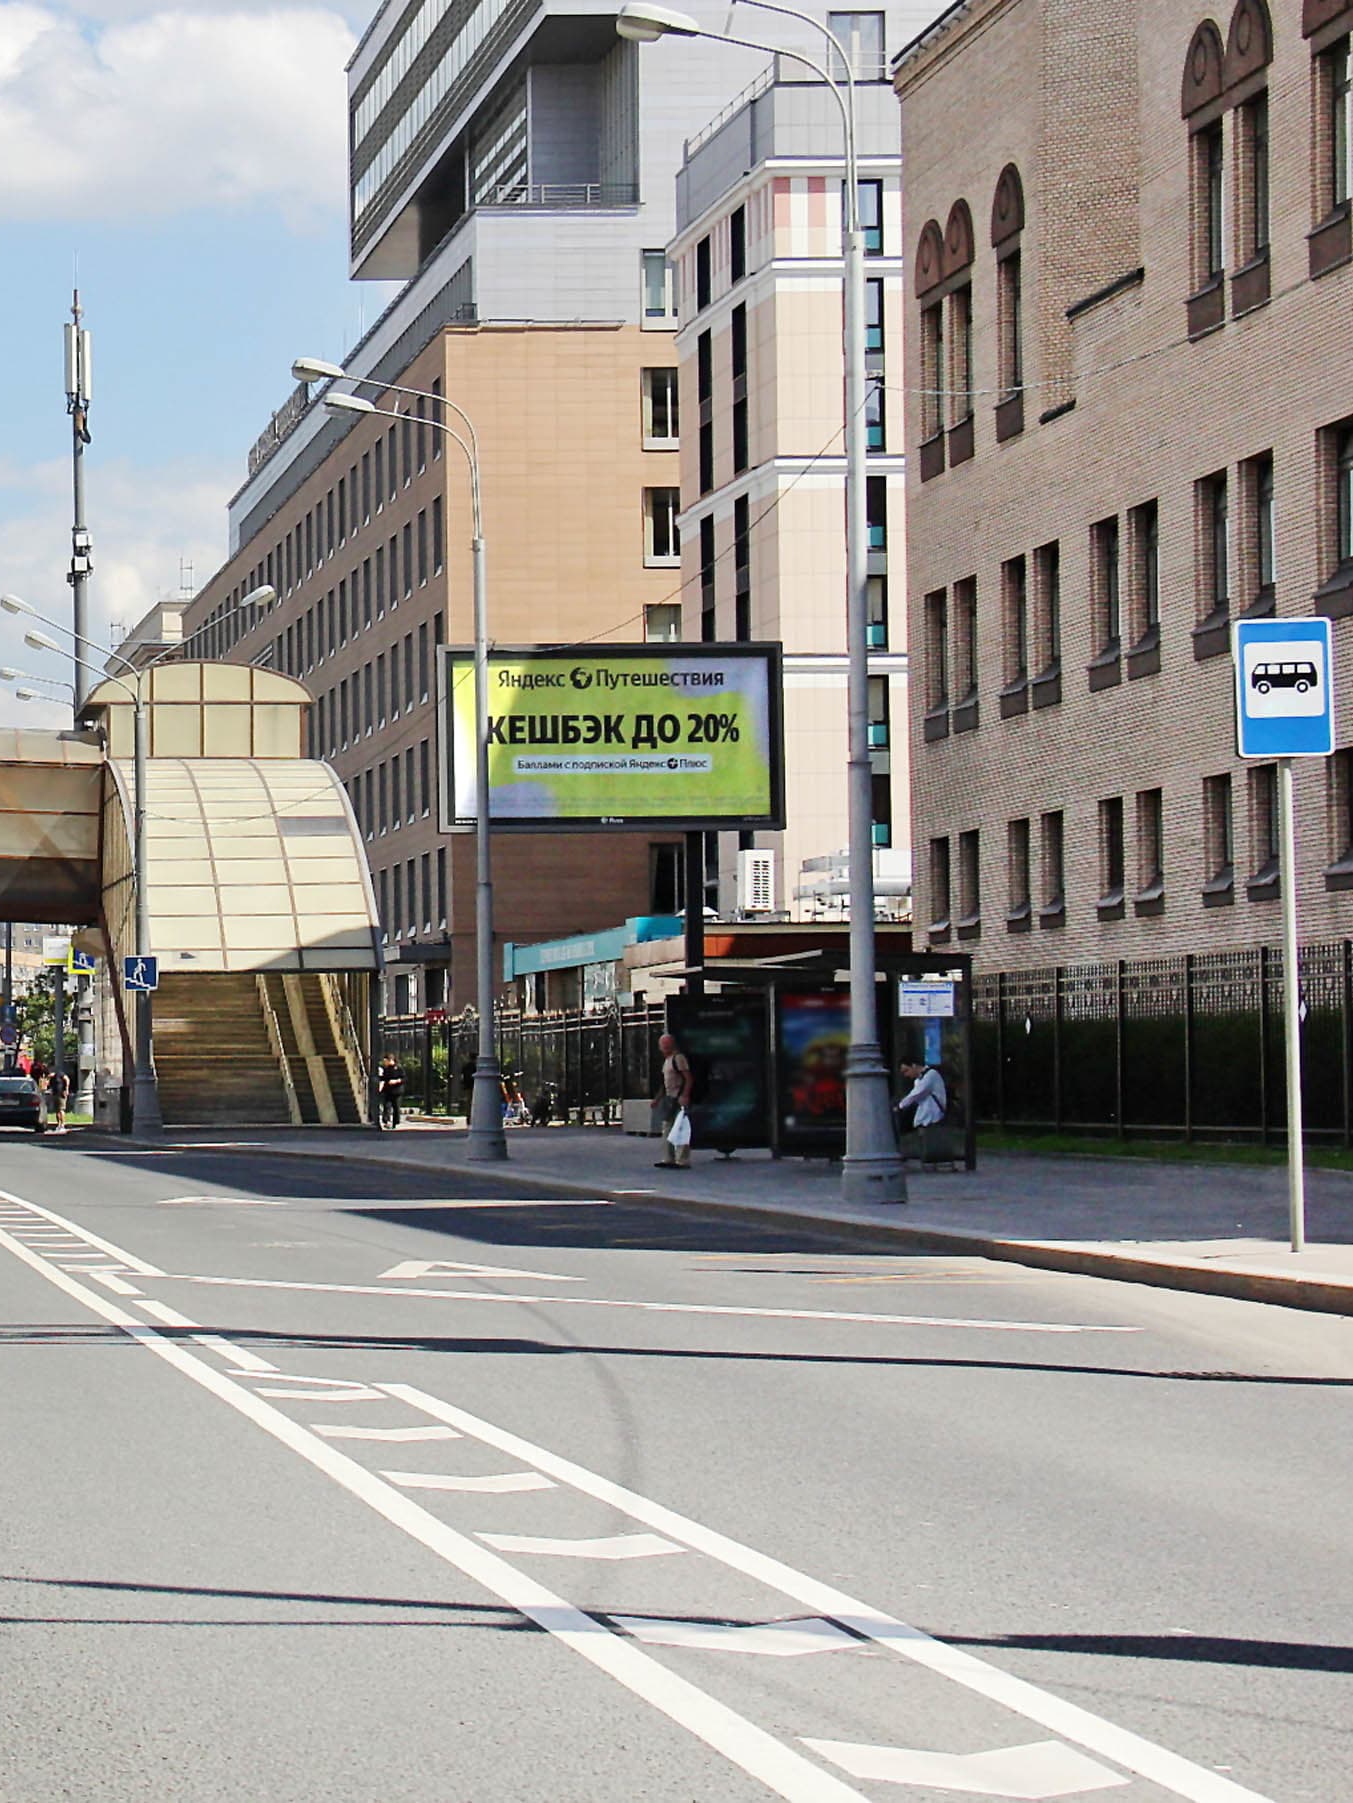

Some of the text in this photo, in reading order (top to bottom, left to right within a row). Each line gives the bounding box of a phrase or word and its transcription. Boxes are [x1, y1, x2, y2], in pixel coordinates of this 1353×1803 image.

[498, 669, 725, 689] Яндекс Путешествия
[488, 713, 740, 749] КЕШБЭК ДО 20%
[517, 759, 563, 769] Баллами
[571, 759, 628, 770] подпиской
[629, 759, 666, 770] Яндекс
[679, 759, 707, 768] Плюс
